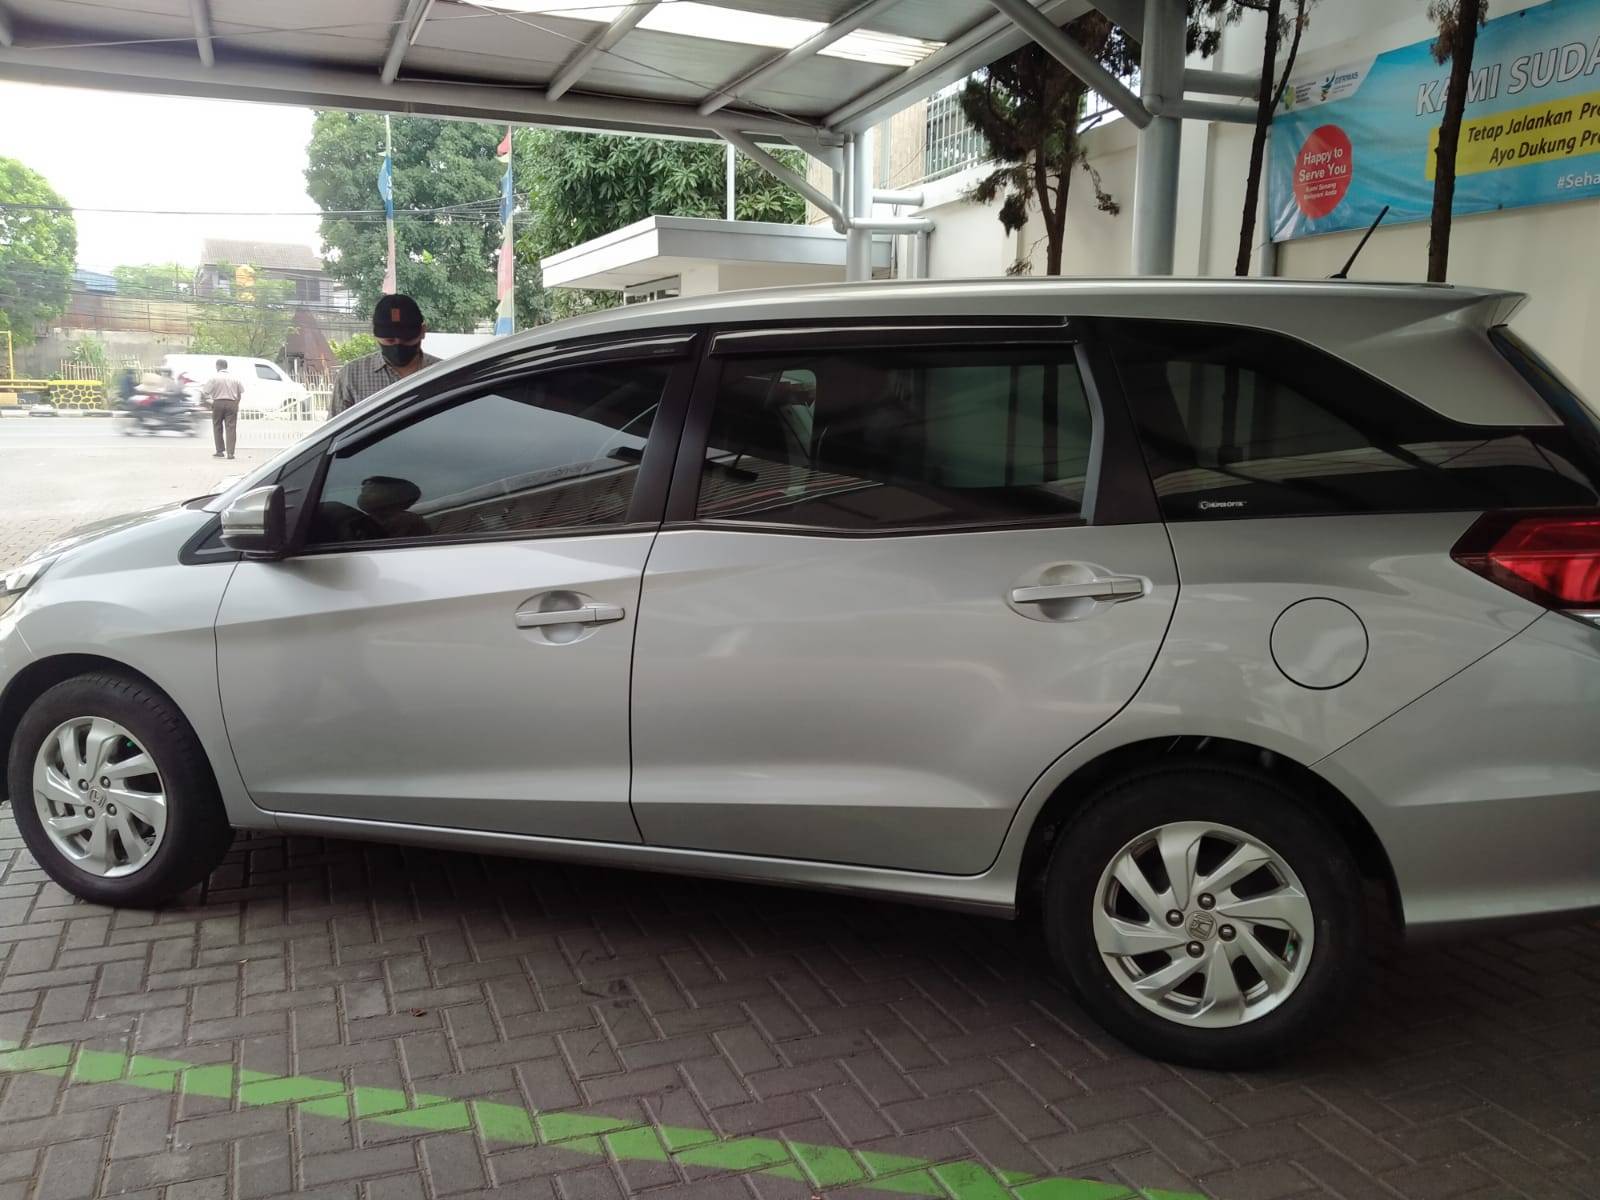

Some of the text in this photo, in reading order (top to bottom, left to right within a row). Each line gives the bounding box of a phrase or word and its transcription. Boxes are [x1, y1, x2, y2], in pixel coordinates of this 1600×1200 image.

[1468, 124, 1504, 142] Tetap
[1505, 109, 1572, 135] Jalankan
[1304, 147, 1343, 166] Happy to
[1489, 147, 1515, 166] Ayo
[1518, 136, 1576, 155] Dukung
[1299, 162, 1346, 182] Serve You
